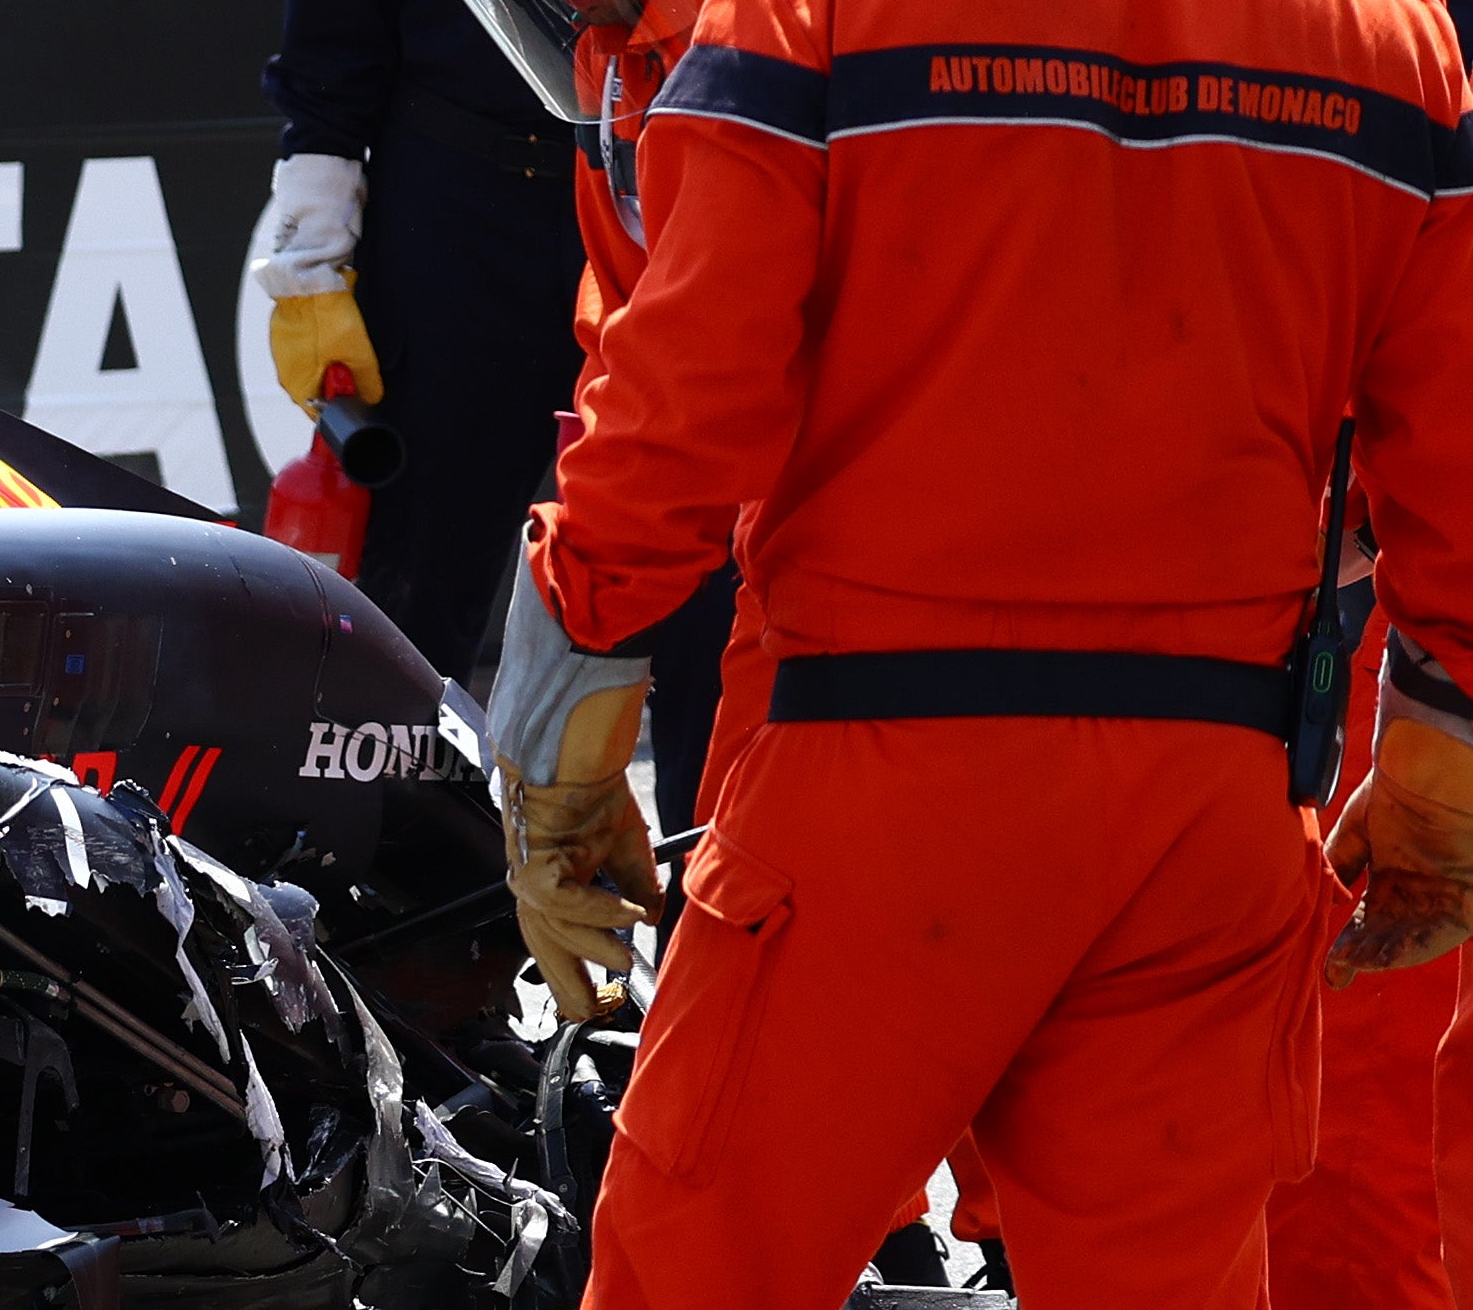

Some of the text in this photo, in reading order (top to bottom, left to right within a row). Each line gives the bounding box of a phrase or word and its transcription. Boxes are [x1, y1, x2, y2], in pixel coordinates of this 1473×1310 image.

[929, 56, 1361, 135] AUTOMOBILE CLUB DE MONACO
